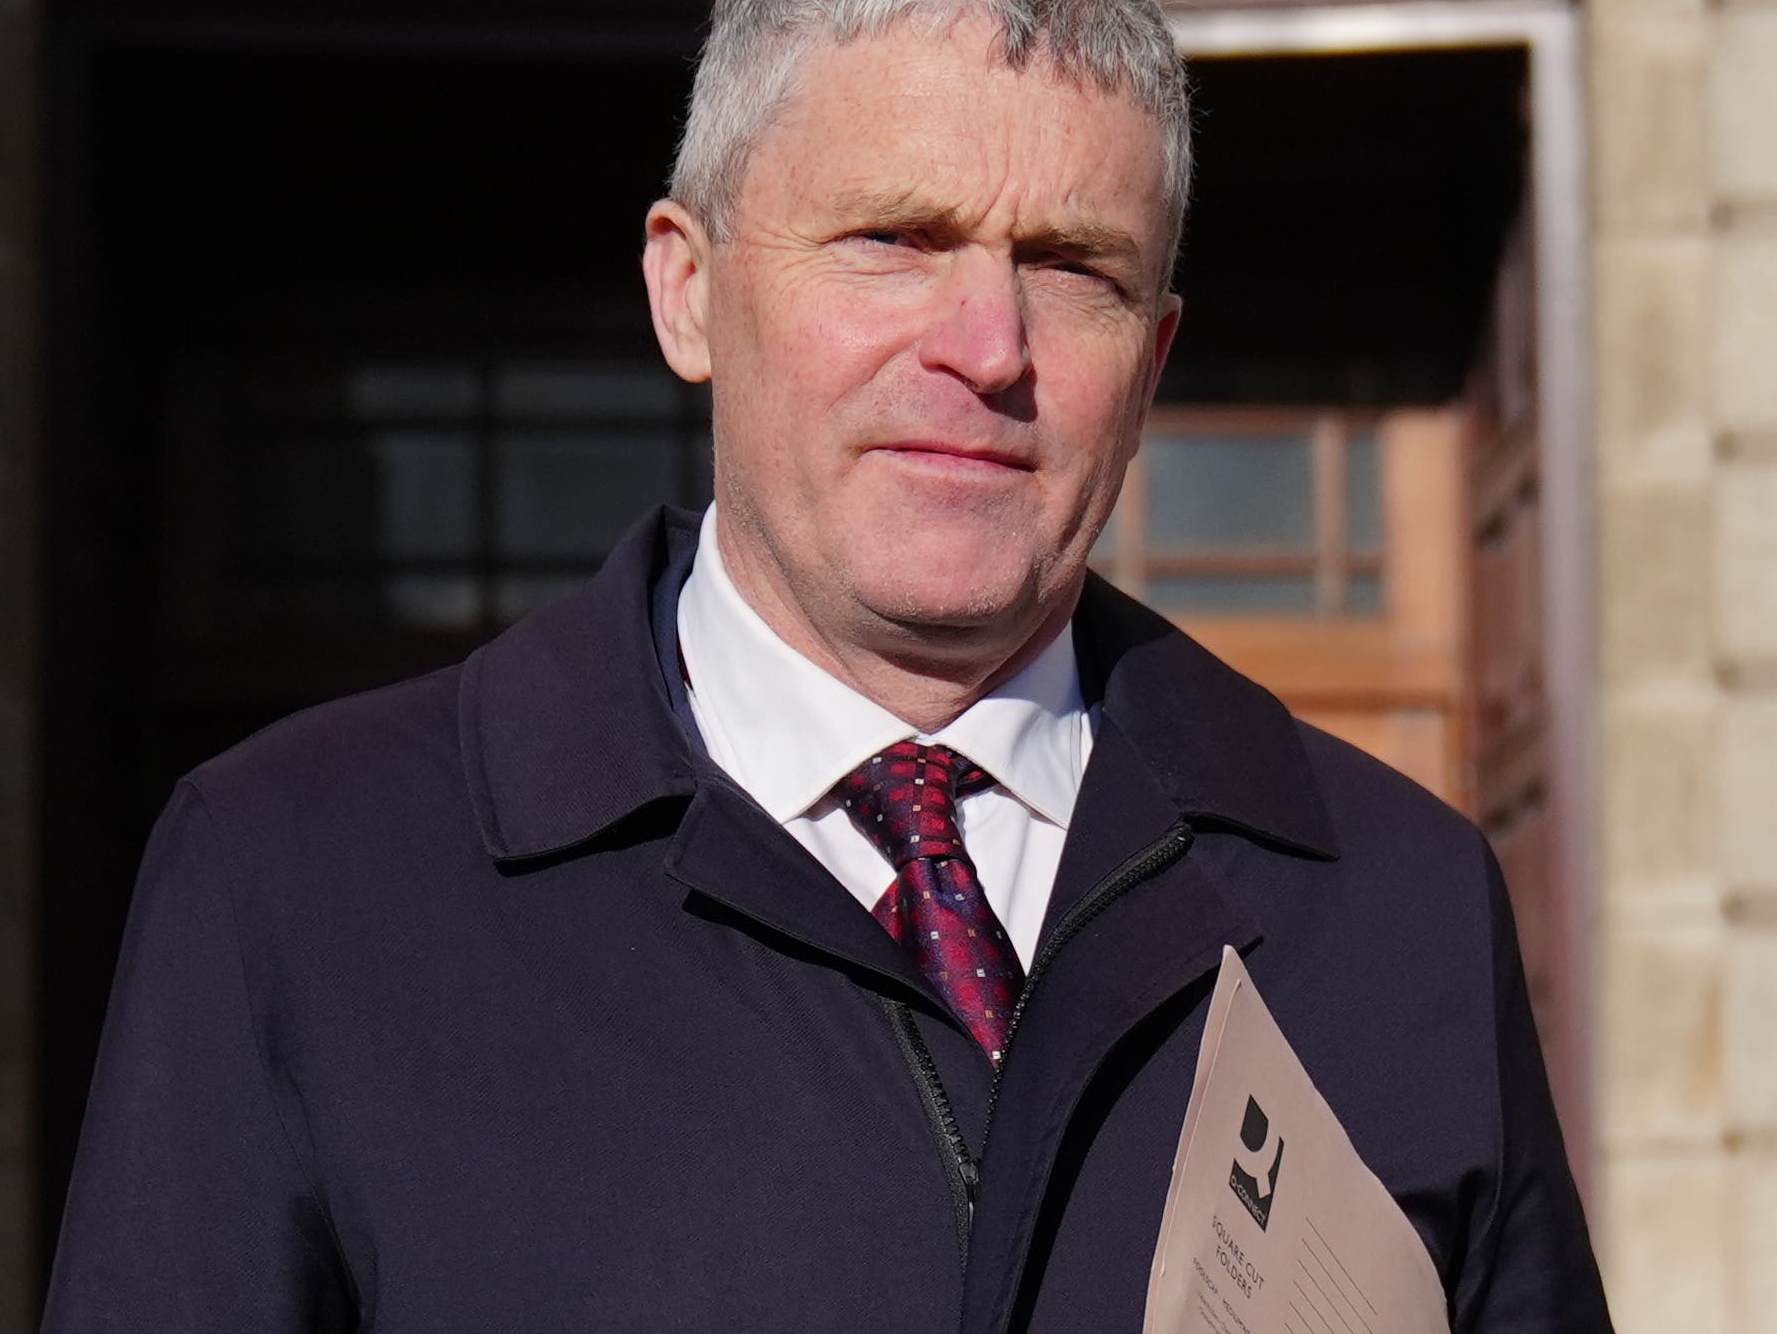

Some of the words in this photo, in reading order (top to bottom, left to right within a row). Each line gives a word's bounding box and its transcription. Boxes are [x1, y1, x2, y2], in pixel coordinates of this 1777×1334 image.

[1212, 1214, 1245, 1266] SQUARE
[1245, 1262, 1265, 1289] CUT
[1215, 1244, 1253, 1299] FOLDERS
